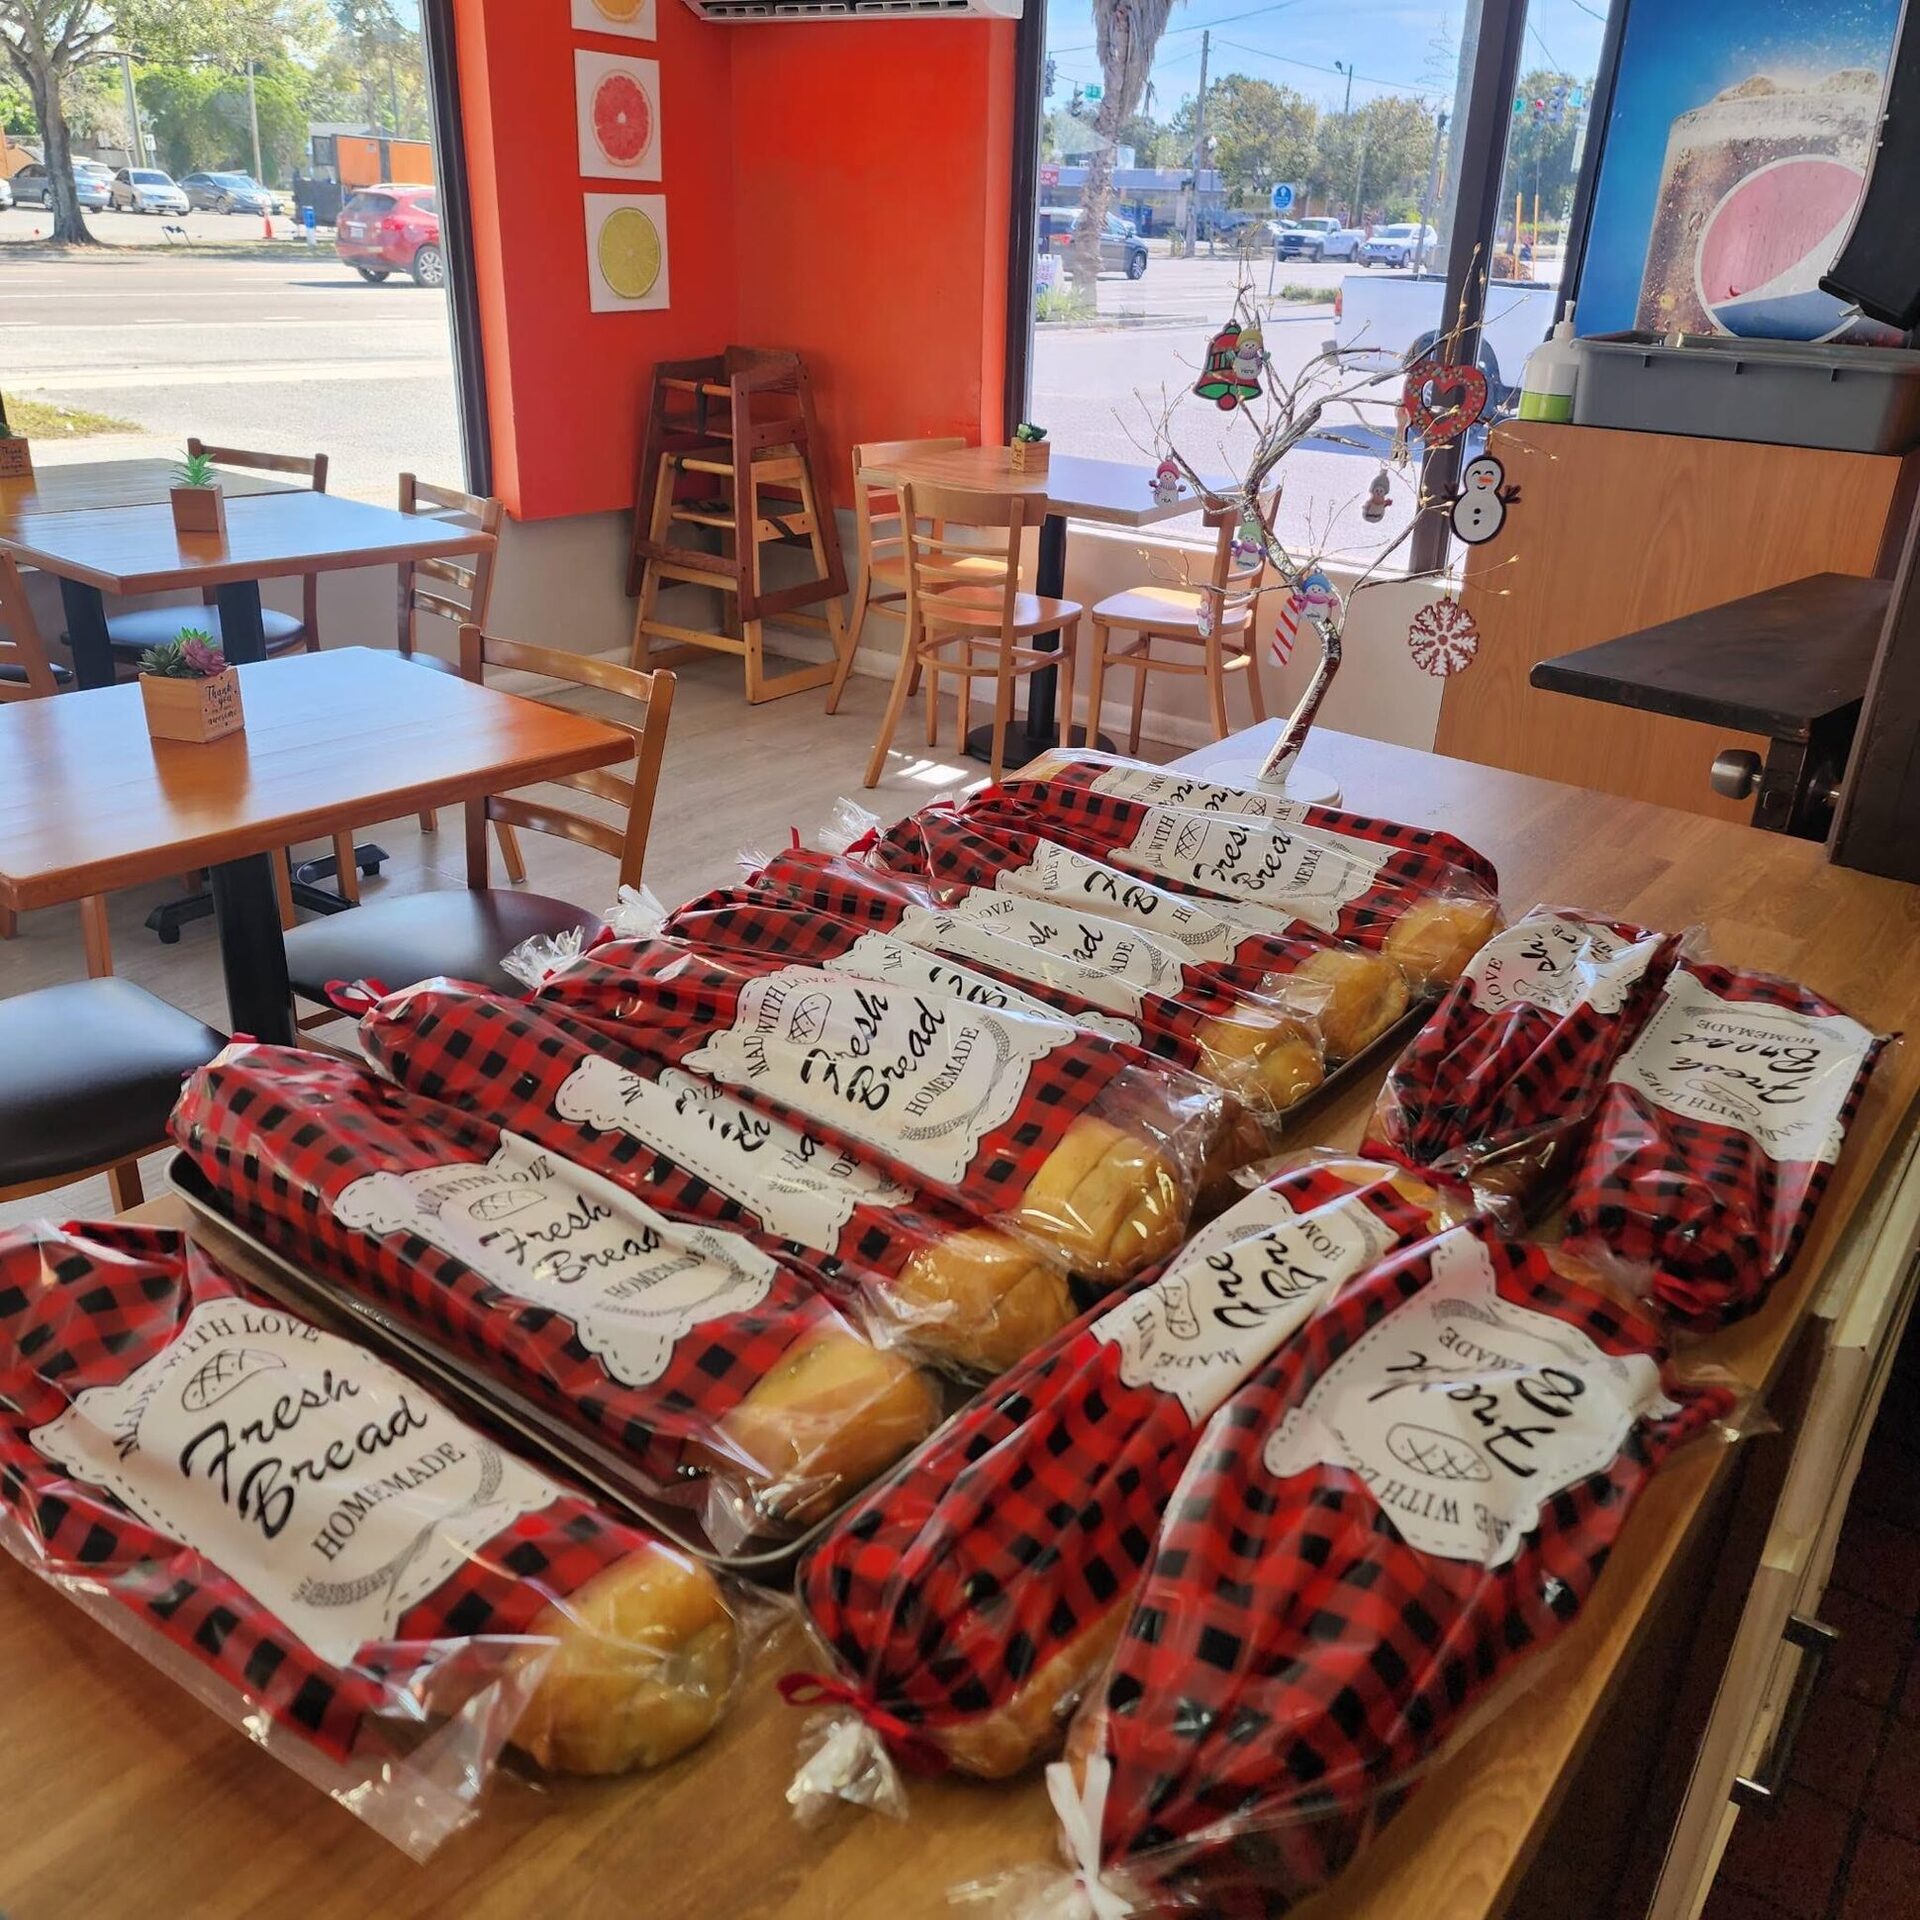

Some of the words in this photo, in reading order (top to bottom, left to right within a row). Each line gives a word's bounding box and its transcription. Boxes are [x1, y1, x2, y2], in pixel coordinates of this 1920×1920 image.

[1148, 814, 1176, 852] WITH
[754, 985, 787, 1034] WITH
[1486, 957, 1508, 1006] LOVE
[801, 989, 889, 1095] Fresh
[847, 997, 945, 1111] Bread
[1671, 1033, 1820, 1073] Bread
[1697, 1019, 1815, 1044] HOMEMADE
[904, 1025, 980, 1117] HOMEMADE
[1668, 1057, 1812, 1103] Fresh
[1688, 1098, 1745, 1122] WITH
[479, 1193, 612, 1266] Fresh
[531, 1225, 664, 1284] Bread
[162, 1317, 236, 1370] WITH
[241, 1313, 322, 1344] LOVE
[179, 1368, 360, 1504] Fresh
[237, 1395, 428, 1539] Bread
[311, 1441, 467, 1562] HOMEMADE
[1379, 1479, 1460, 1525] WITH
